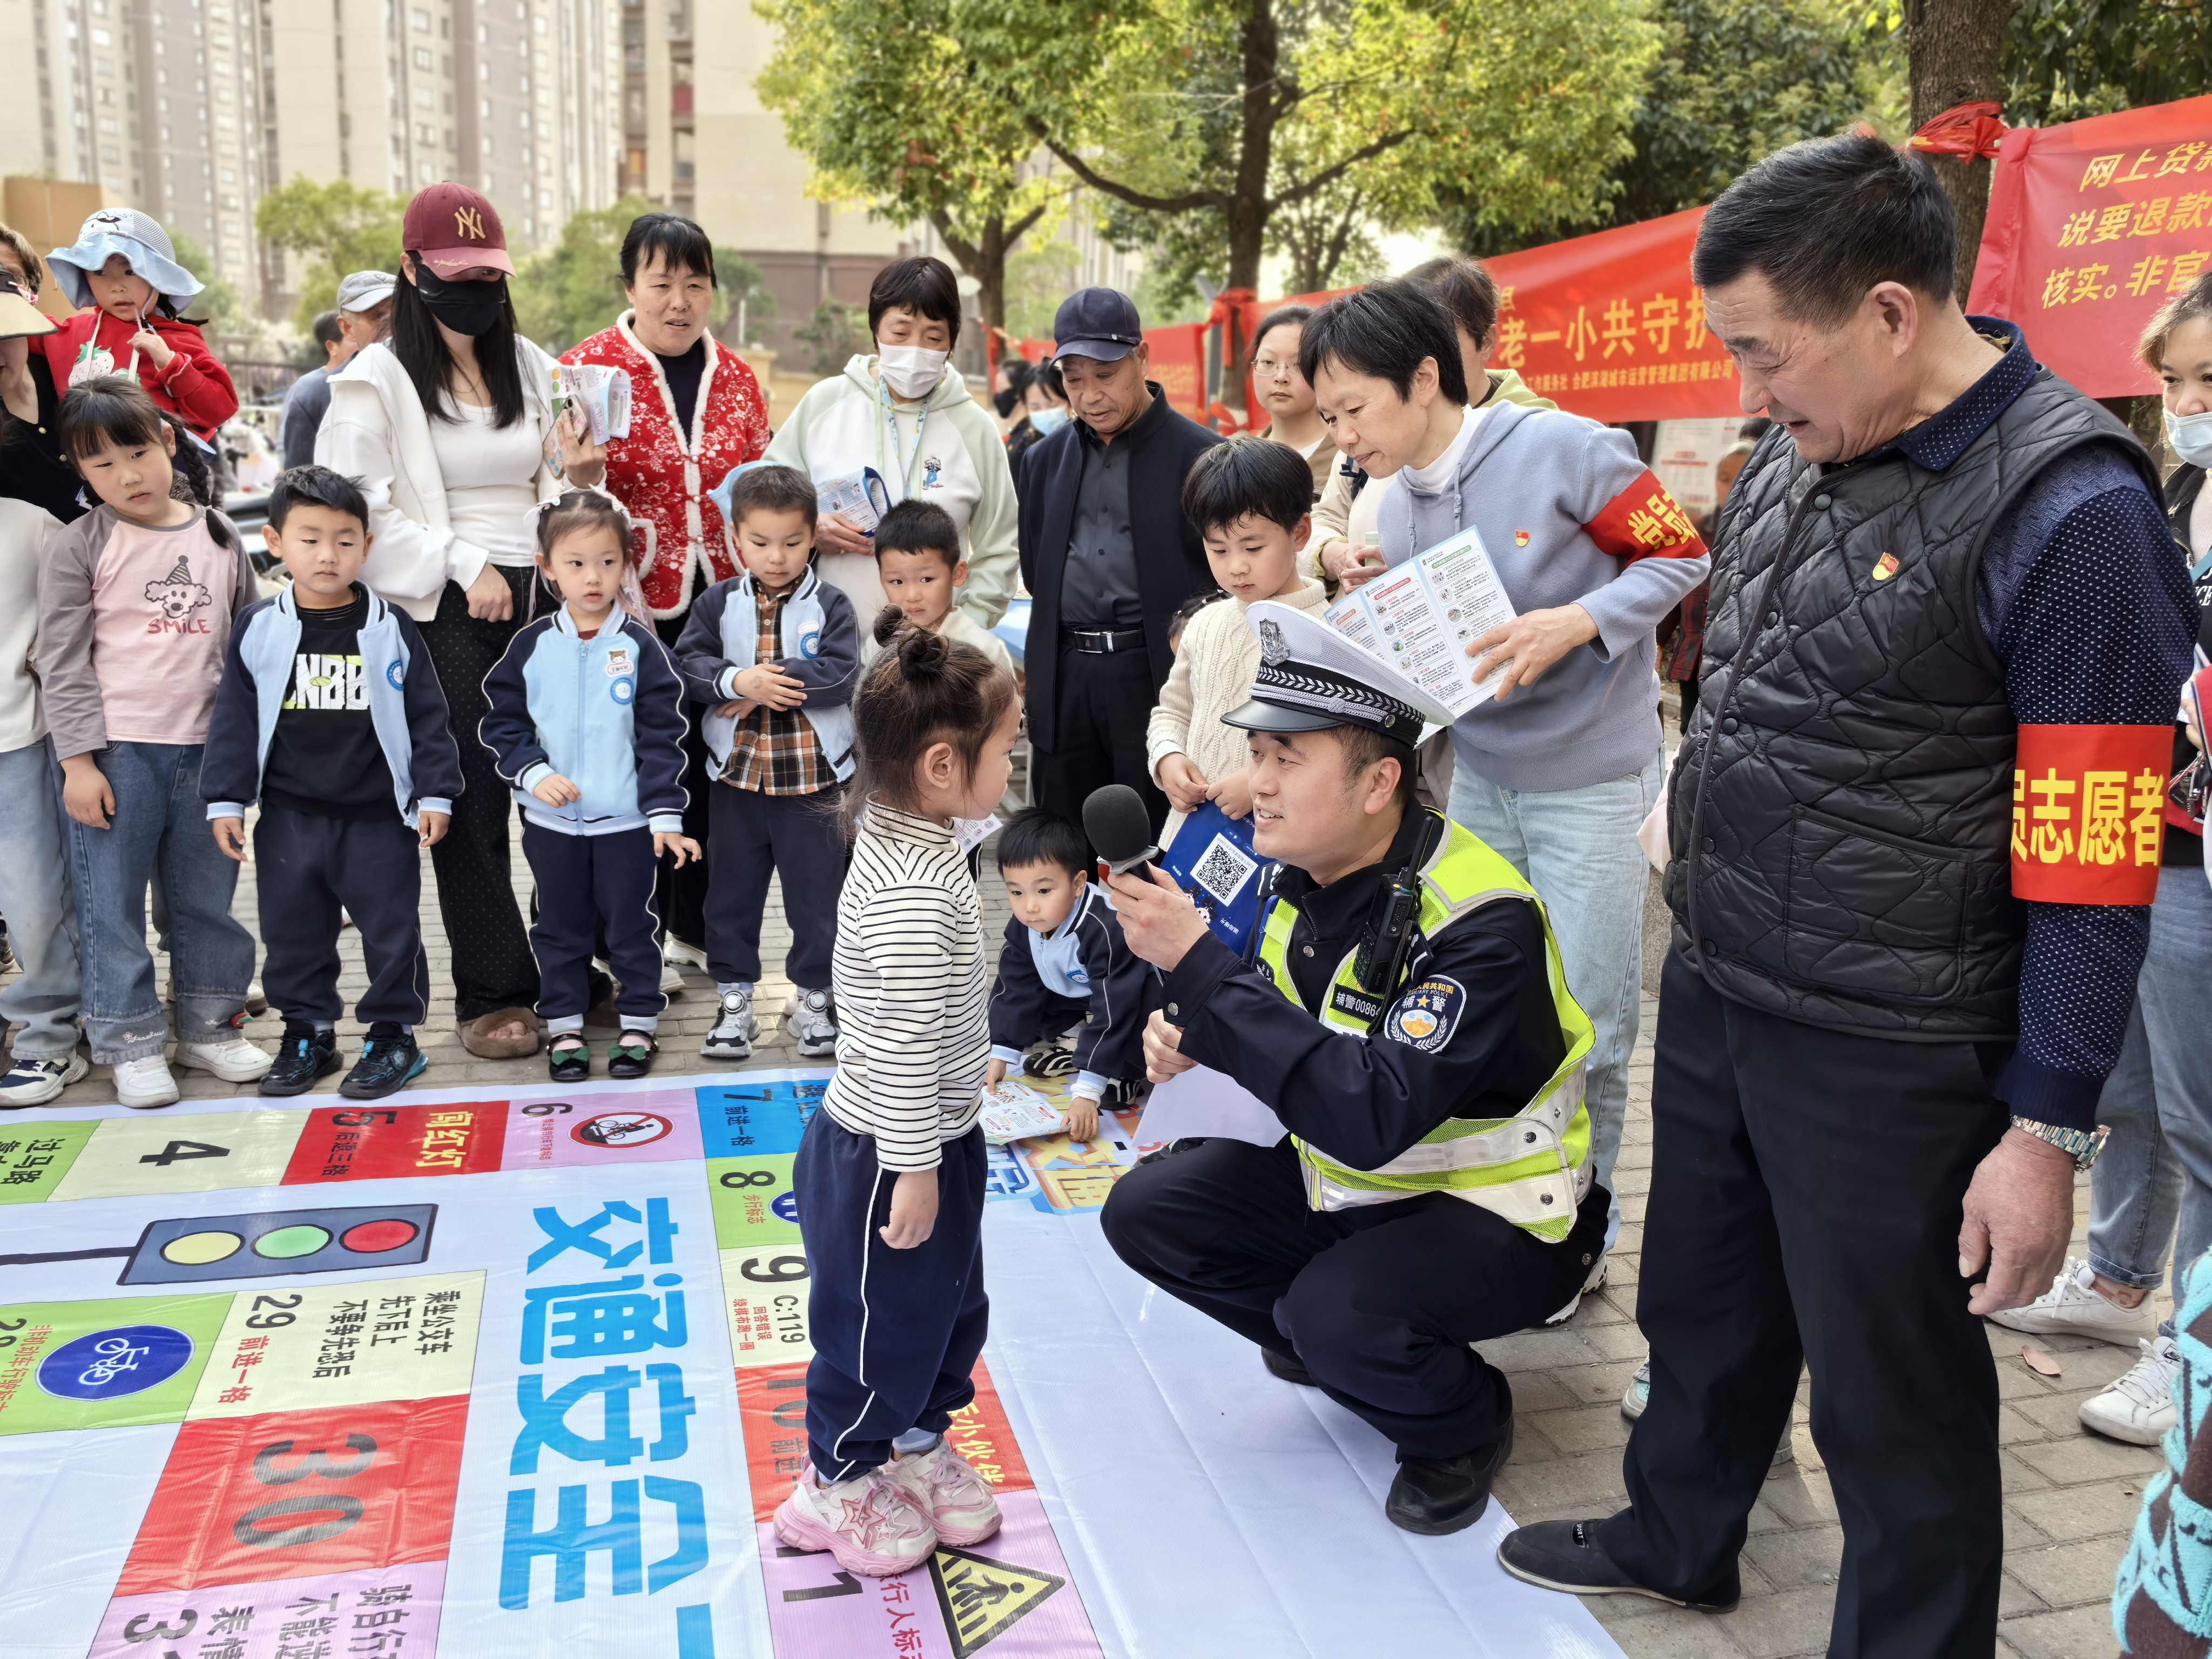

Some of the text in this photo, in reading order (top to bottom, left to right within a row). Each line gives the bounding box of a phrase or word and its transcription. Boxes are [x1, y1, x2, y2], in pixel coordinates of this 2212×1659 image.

[454, 206, 485, 239] NY
[2058, 190, 2212, 247] 说要退款
[1521, 373, 1568, 392] 工作服务社
[332, 1110, 397, 1127] 5
[522, 1102, 573, 1117] 6
[724, 1088, 772, 1102] 7
[416, 1110, 474, 1169] 闯红灯
[724, 1105, 755, 1147] 前进一格
[7, 1137, 68, 1186] 过马路
[139, 1140, 231, 1166] 4
[322, 1131, 367, 1177] 后退三格
[719, 1171, 777, 1189] 8
[743, 1194, 767, 1225] 步行标志
[740, 1255, 810, 1283] 9
[245, 1293, 304, 1330] 29
[370, 1295, 416, 1348] 先下后上
[415, 1289, 461, 1355] 乘坐公交车
[753, 1306, 772, 1340] 回答错误
[773, 1294, 807, 1344] C:119
[312, 1299, 369, 1379] 不要争先恐后
[218, 1334, 269, 1404] 前进一格
[499, 1197, 716, 1659] 交通安全
[232, 1433, 378, 1548] 30
[770, 1437, 805, 1502] 前进一
[347, 1582, 413, 1659] 骑自行
[878, 1572, 922, 1659] 行人标
